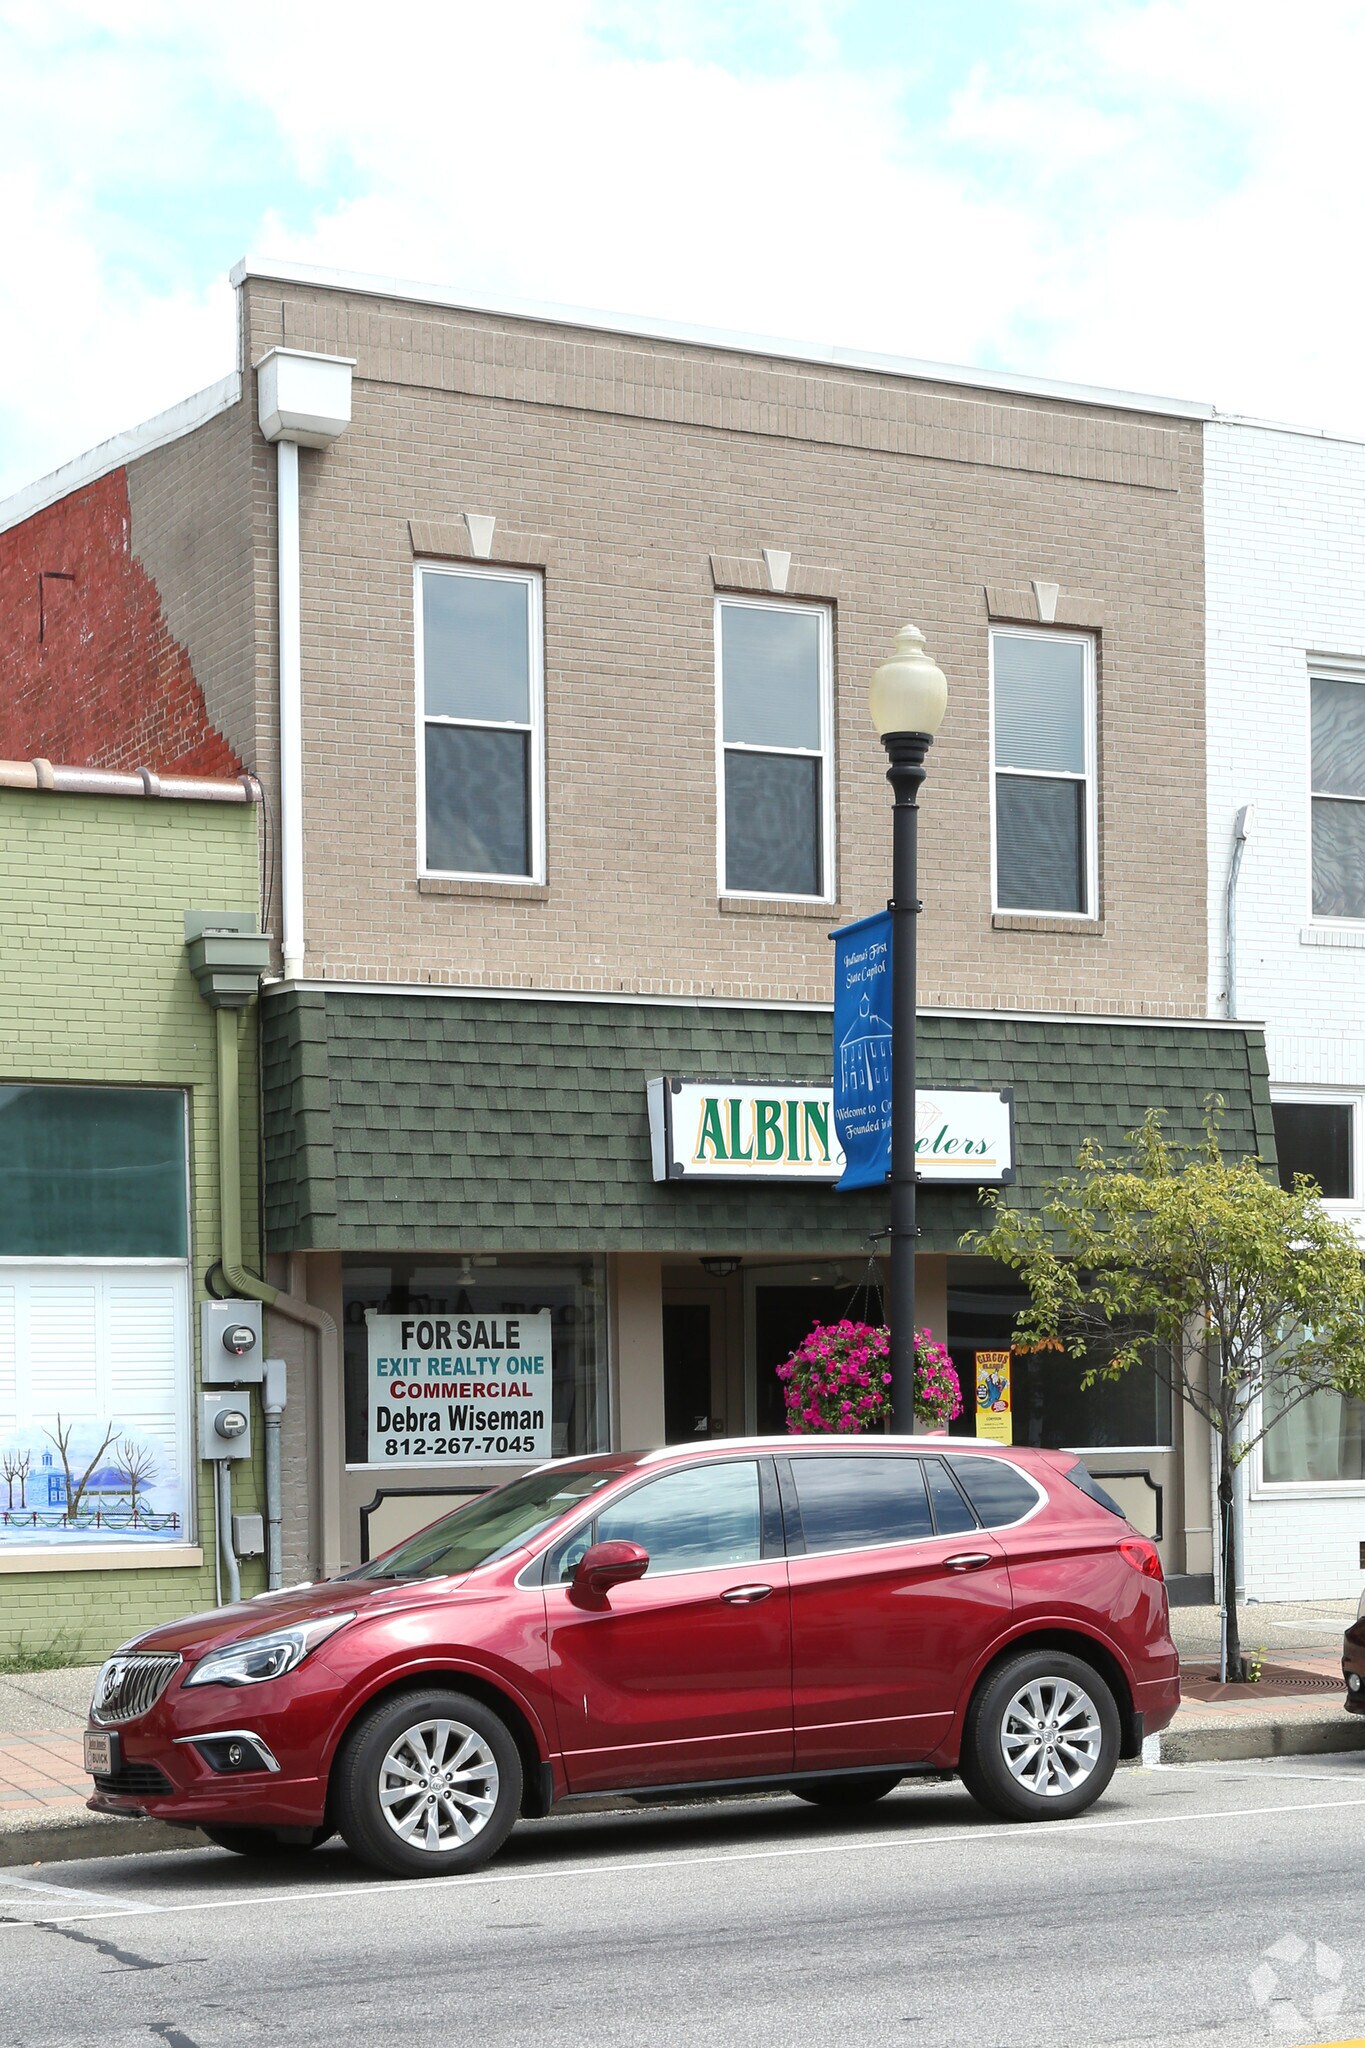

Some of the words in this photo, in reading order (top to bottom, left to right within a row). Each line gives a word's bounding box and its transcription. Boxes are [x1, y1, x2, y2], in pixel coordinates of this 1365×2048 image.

[868, 942, 888, 961] First
[845, 971, 861, 989] State
[861, 959, 886, 981] Capitol
[836, 1106, 866, 1121] Welcome
[868, 1104, 877, 1114] to
[694, 1098, 831, 1166] ALBIN
[845, 1118, 880, 1140] Founded
[401, 1320, 451, 1351] FOR
[456, 1320, 520, 1350] SALE
[377, 1357, 421, 1377] EXIT
[427, 1356, 501, 1376] REALTY
[506, 1356, 544, 1375] ONE
[977, 1353, 1009, 1365] CIRCUS
[376, 1406, 441, 1433] Debra
[448, 1404, 544, 1431] Wiseman
[385, 1436, 535, 1456] 812-267-7045
[92, 1753, 109, 1764] BUICK
